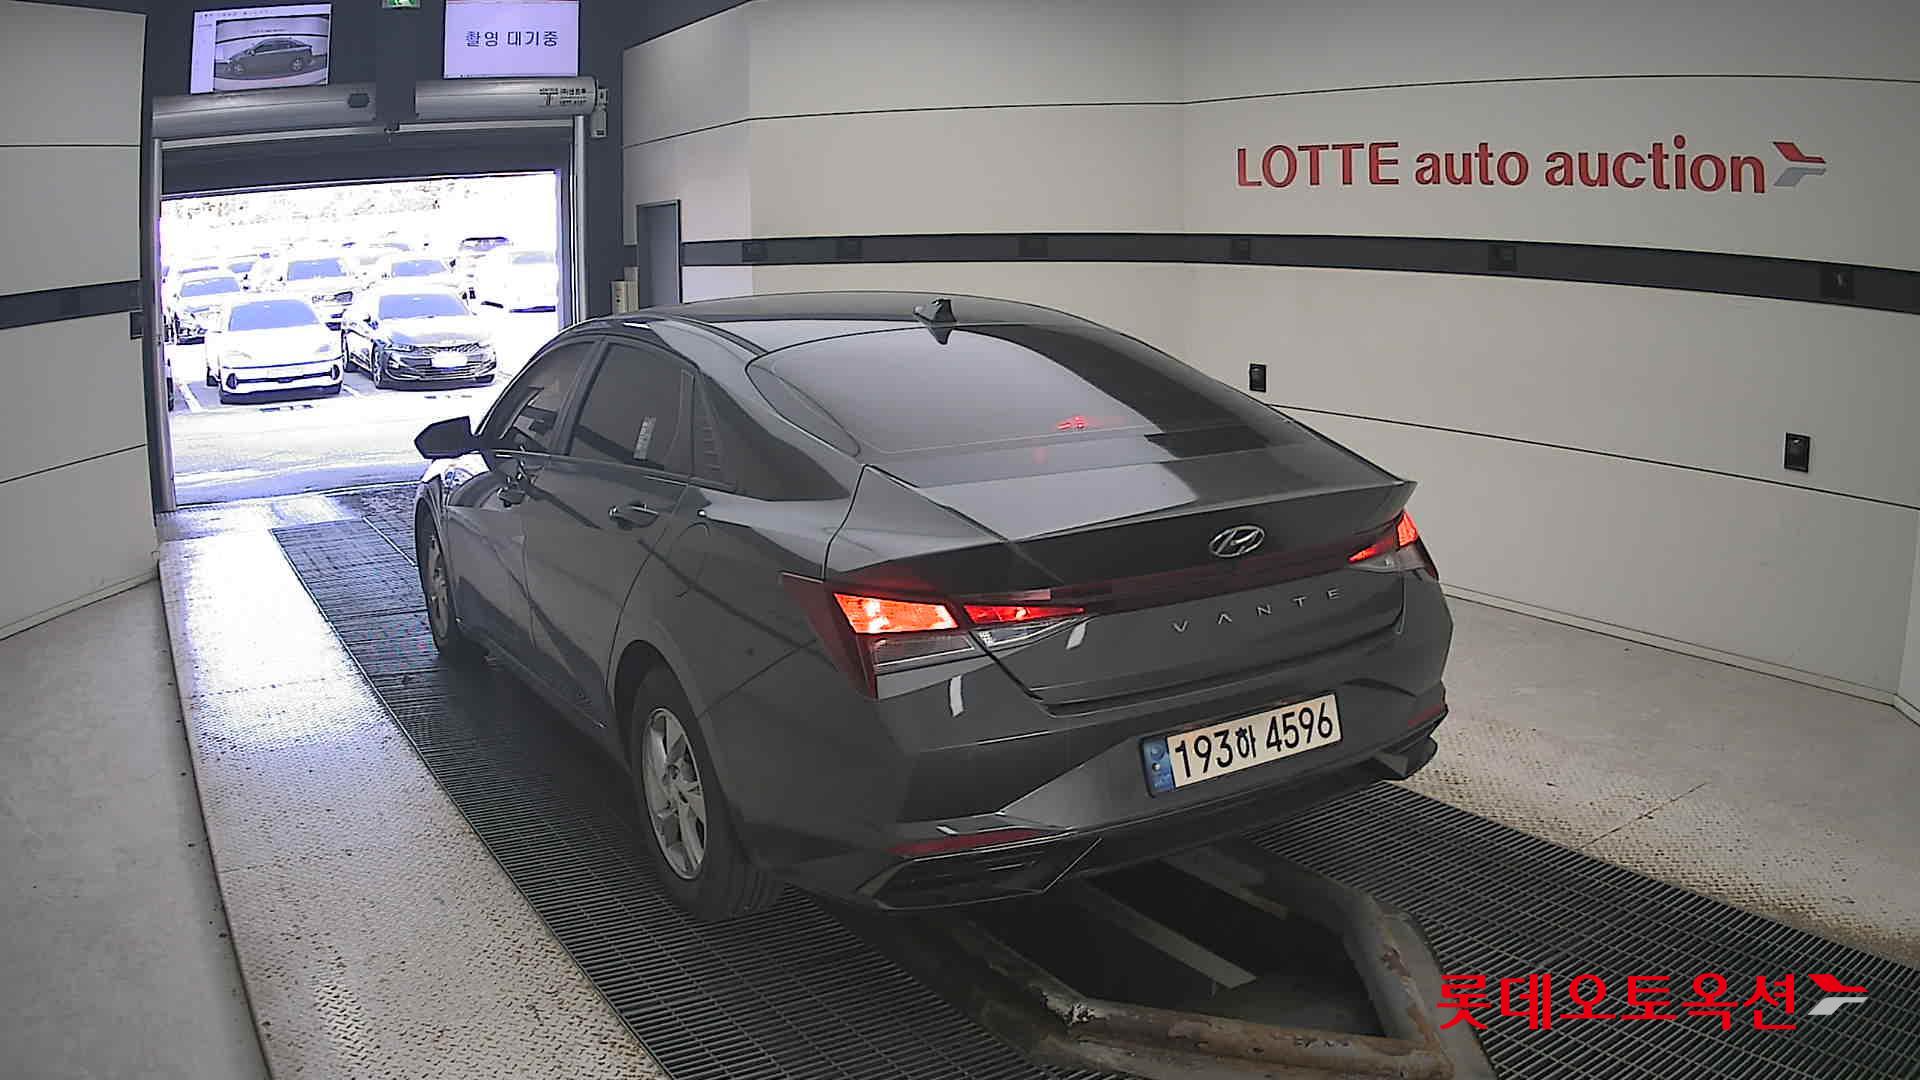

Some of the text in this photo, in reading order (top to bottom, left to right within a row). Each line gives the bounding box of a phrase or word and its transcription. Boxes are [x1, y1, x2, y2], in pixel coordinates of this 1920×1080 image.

[507, 31, 558, 47] 대기중
[1237, 134, 1765, 194] LOTTE auto auction
[1174, 702, 1333, 778] 193하 4596
